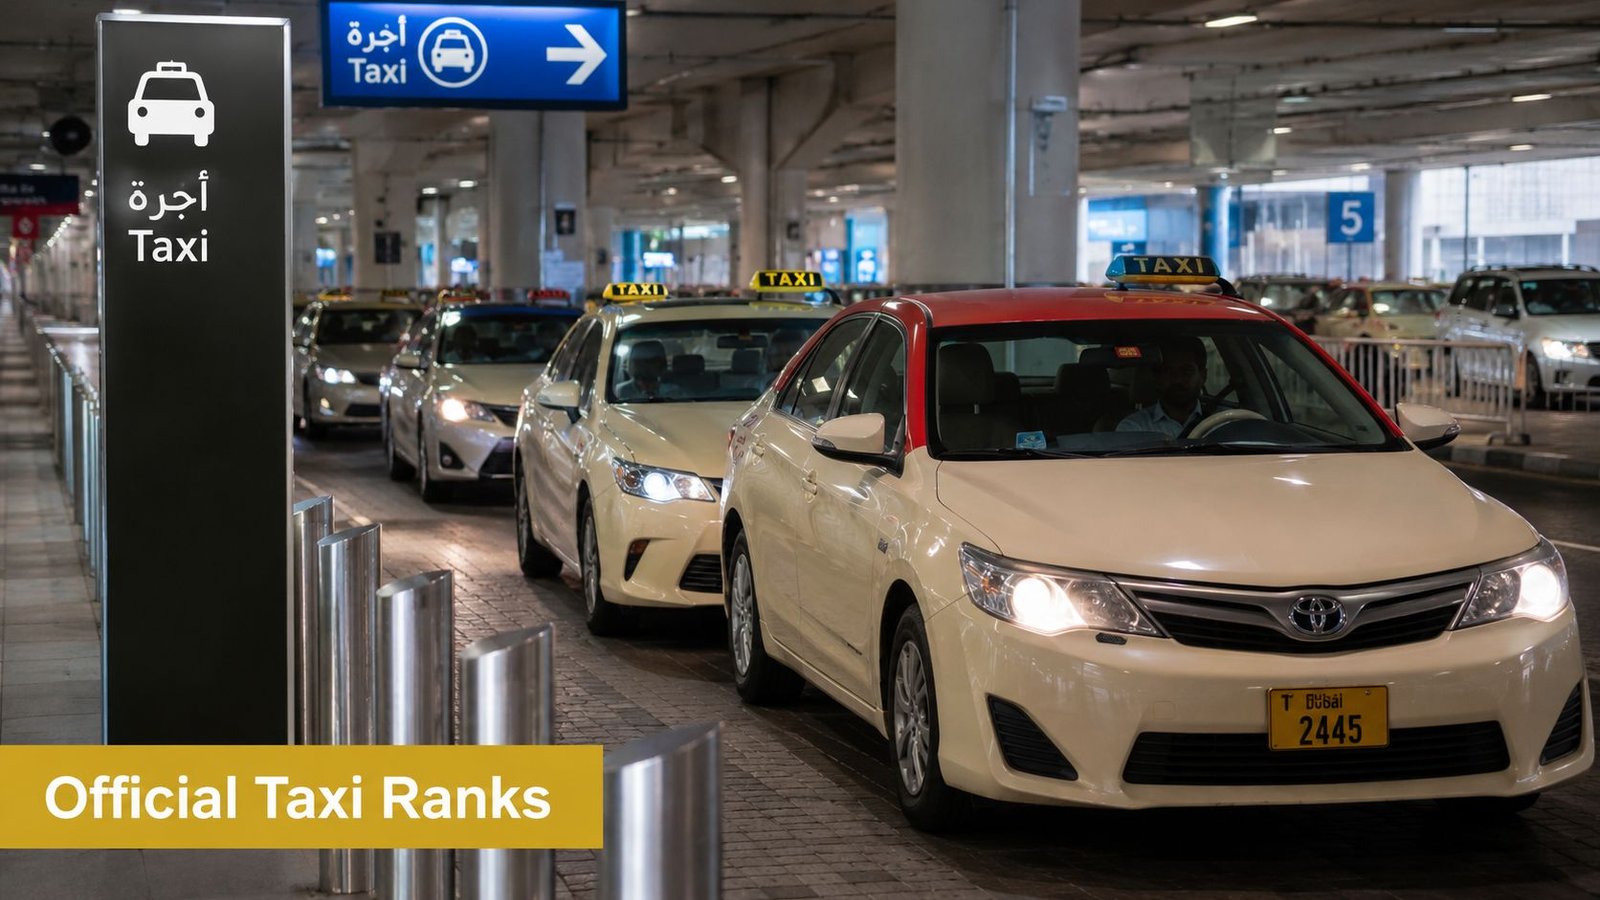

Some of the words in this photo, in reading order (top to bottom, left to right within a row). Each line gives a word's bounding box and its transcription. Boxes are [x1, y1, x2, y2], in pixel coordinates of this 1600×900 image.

[347, 57, 407, 84] Taxi
[128, 169, 209, 221] أجرة
[1340, 200, 1363, 236] 5
[127, 228, 208, 263] Taxi
[1133, 257, 1204, 273] TAXI
[617, 283, 658, 296] TAXI
[765, 272, 815, 286] TAXI
[1281, 694, 1293, 711] T
[1299, 714, 1362, 746] 2445
